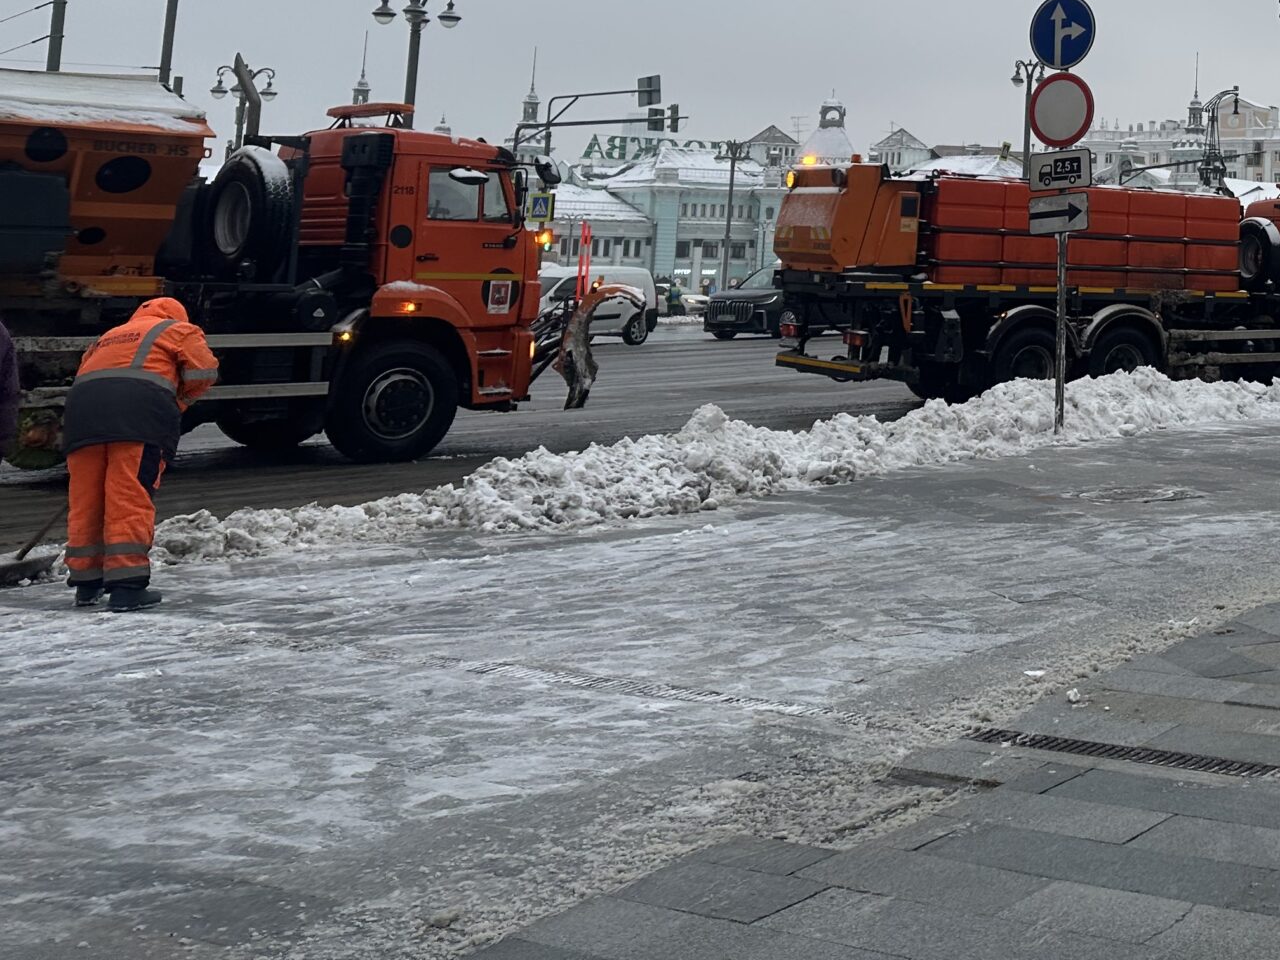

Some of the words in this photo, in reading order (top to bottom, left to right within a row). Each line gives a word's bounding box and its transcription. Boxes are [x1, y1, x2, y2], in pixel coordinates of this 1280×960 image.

[94, 140, 157, 154] BUCHER
[1056, 161, 1070, 173] 2,5
[393, 186, 415, 195] 2118
